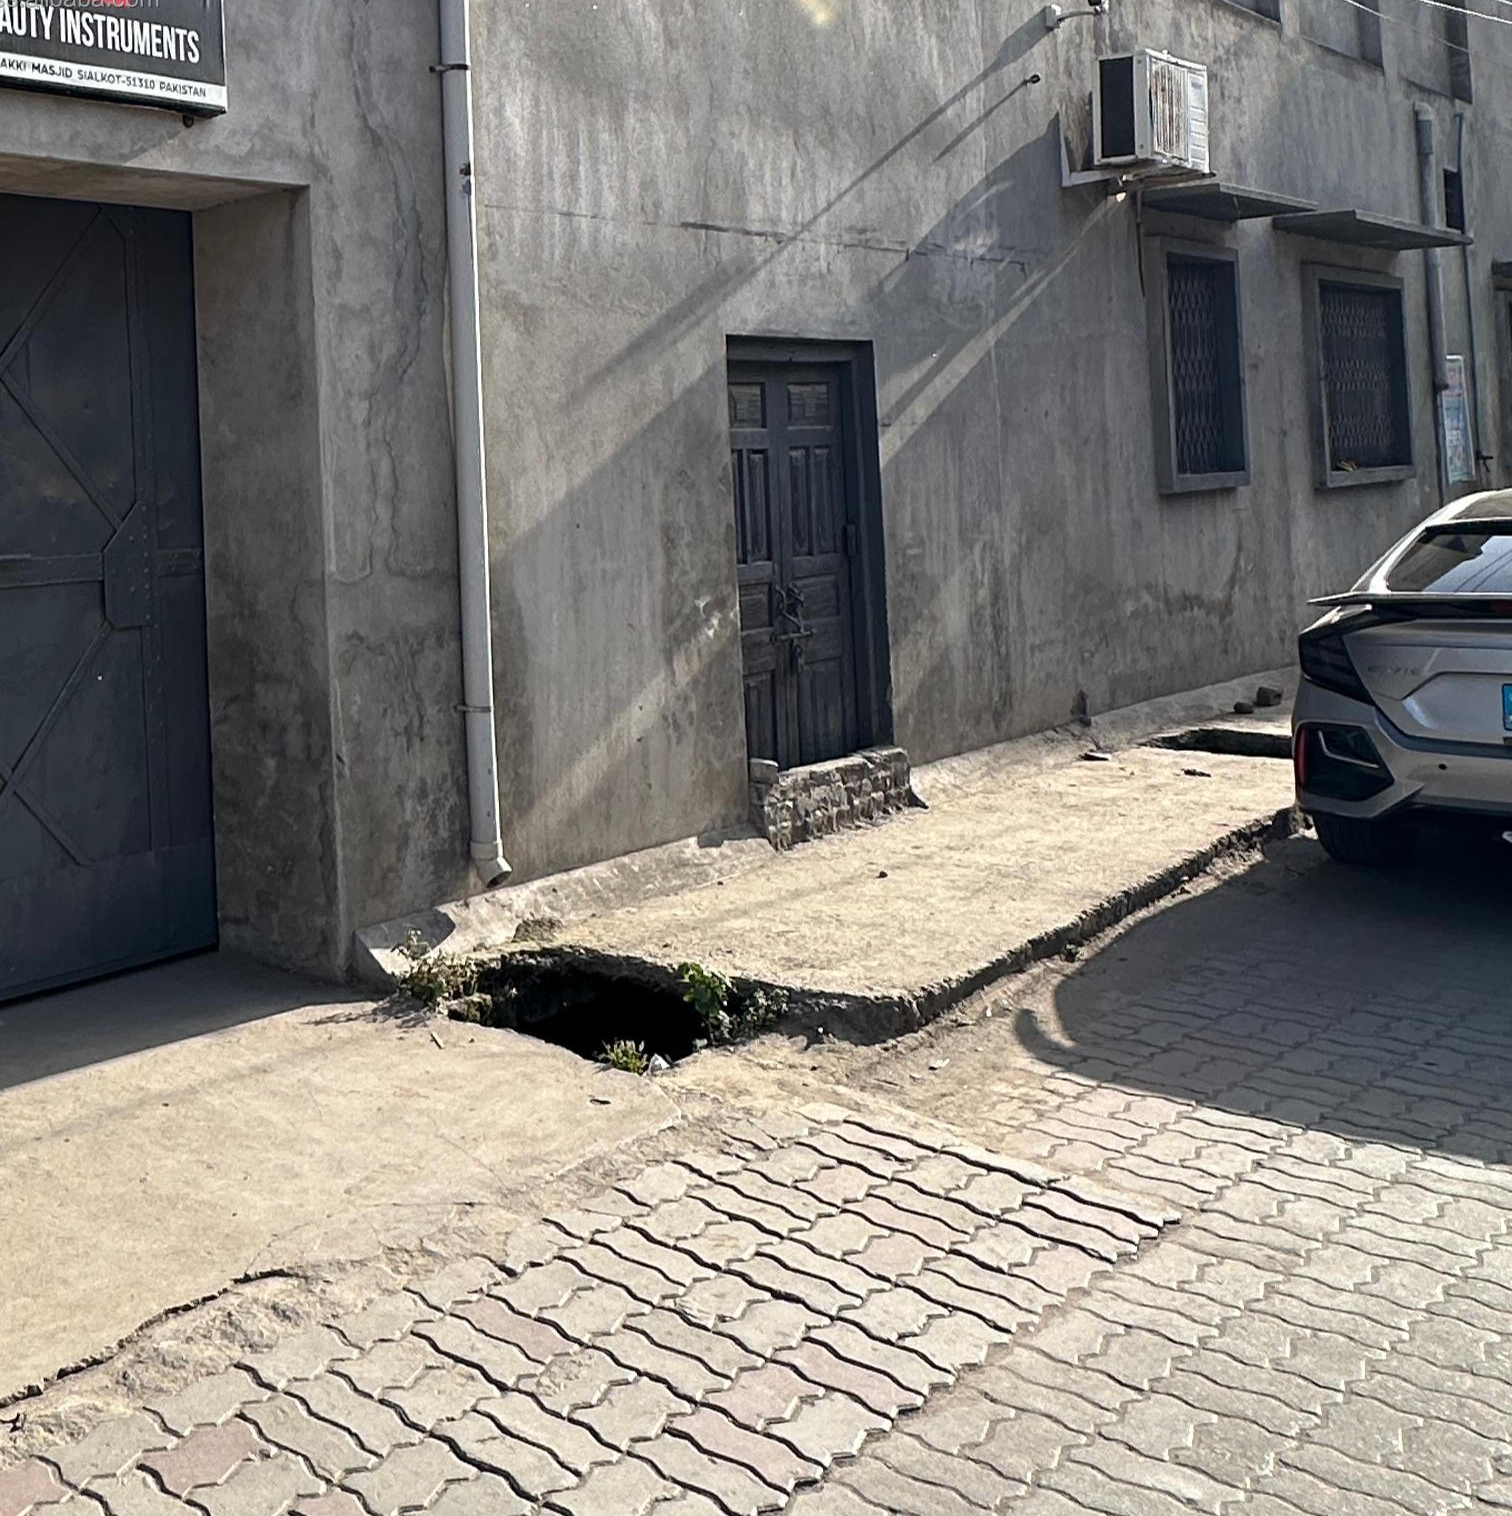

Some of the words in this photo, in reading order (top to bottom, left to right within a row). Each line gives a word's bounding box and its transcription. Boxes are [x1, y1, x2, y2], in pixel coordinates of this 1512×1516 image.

[59, 7, 201, 64] INSTRUMENTS
[31, 62, 73, 79] MASJID
[159, 81, 207, 98] PAKISTAN
